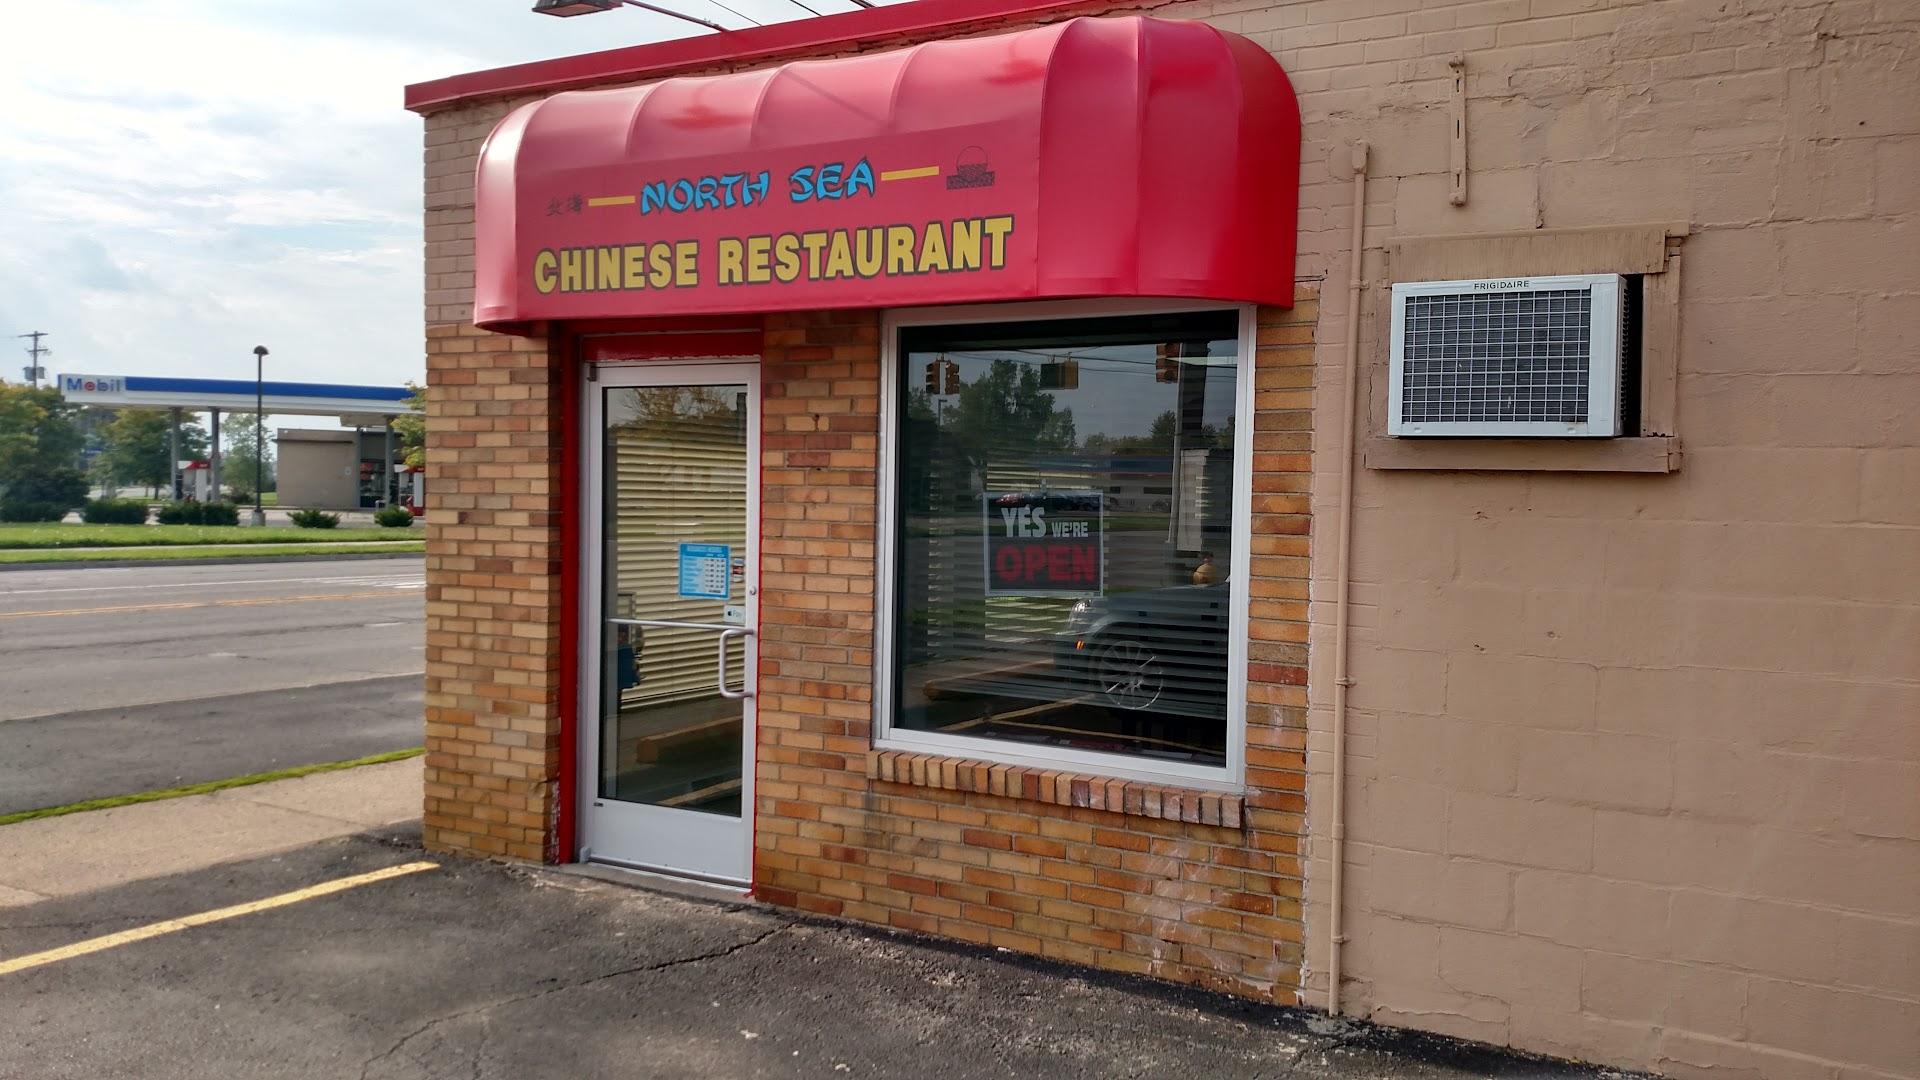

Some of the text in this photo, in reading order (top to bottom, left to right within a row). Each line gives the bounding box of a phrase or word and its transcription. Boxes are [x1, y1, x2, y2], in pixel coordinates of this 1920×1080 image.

[640, 156, 877, 216] NORTH SEA
[534, 215, 1015, 295] CHINESE RESTAURANT
[1474, 280, 1529, 290] FRIGIDAIRE
[66, 376, 121, 392] Mobil
[1001, 506, 1089, 538] YES WE'RE
[997, 545, 1096, 583] OPEN
